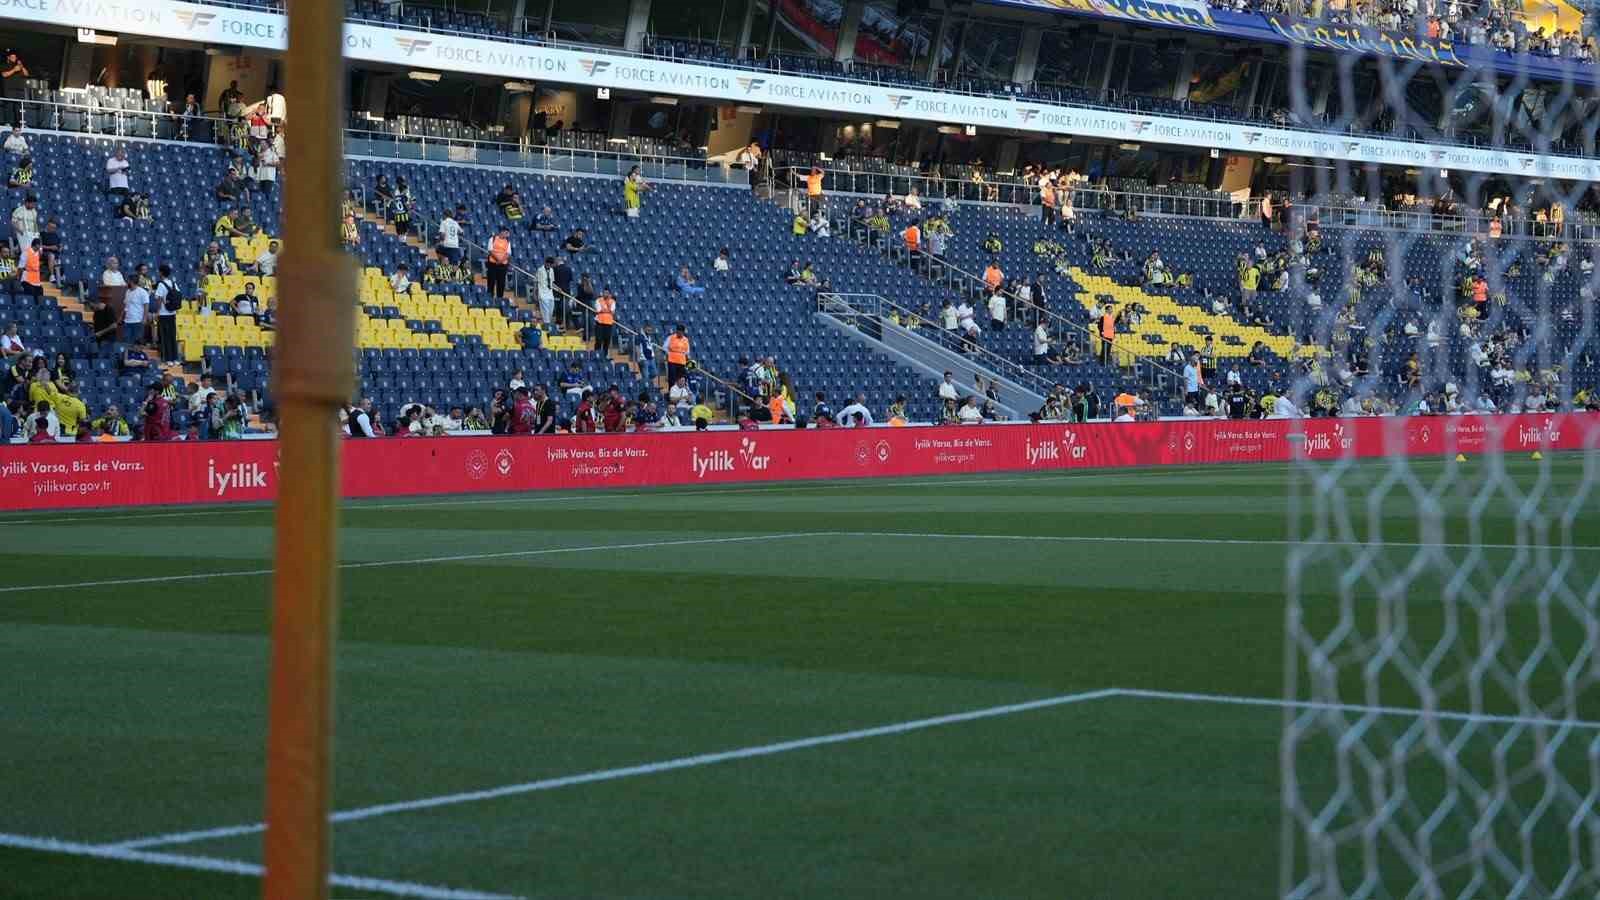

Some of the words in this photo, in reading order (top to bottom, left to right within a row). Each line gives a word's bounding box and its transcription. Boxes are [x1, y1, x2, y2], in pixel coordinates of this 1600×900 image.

[222, 19, 275, 39] FORCE
[435, 46, 482, 63] FORCE
[487, 51, 568, 72] AVIATION
[615, 66, 655, 82] FORCE
[659, 71, 730, 89] AVIATION
[768, 82, 806, 98] FORCE
[807, 87, 872, 104] AVIATION
[915, 99, 949, 113] FORCE
[951, 103, 1008, 119] AVIATION
[1042, 114, 1072, 127] FORCE
[1074, 116, 1126, 131] AVIATION
[1155, 124, 1182, 137] FORCE
[1183, 126, 1231, 142] AVIATION
[1264, 135, 1289, 148] FORCE
[1290, 138, 1335, 152] AVIATION
[1386, 147, 1427, 161] AVIATION
[612, 447, 624, 457] de
[1026, 437, 1059, 465] İyilik
[0, 460, 28, 478] yilik
[31, 462, 69, 474] Varsa,
[73, 460, 91, 472] Biz
[94, 459, 109, 471] de
[111, 459, 145, 471] Varız.
[692, 447, 735, 478] İyilik
[208, 458, 268, 497] İyilik
[33, 479, 112, 497] iyilikvar.gov.tr
